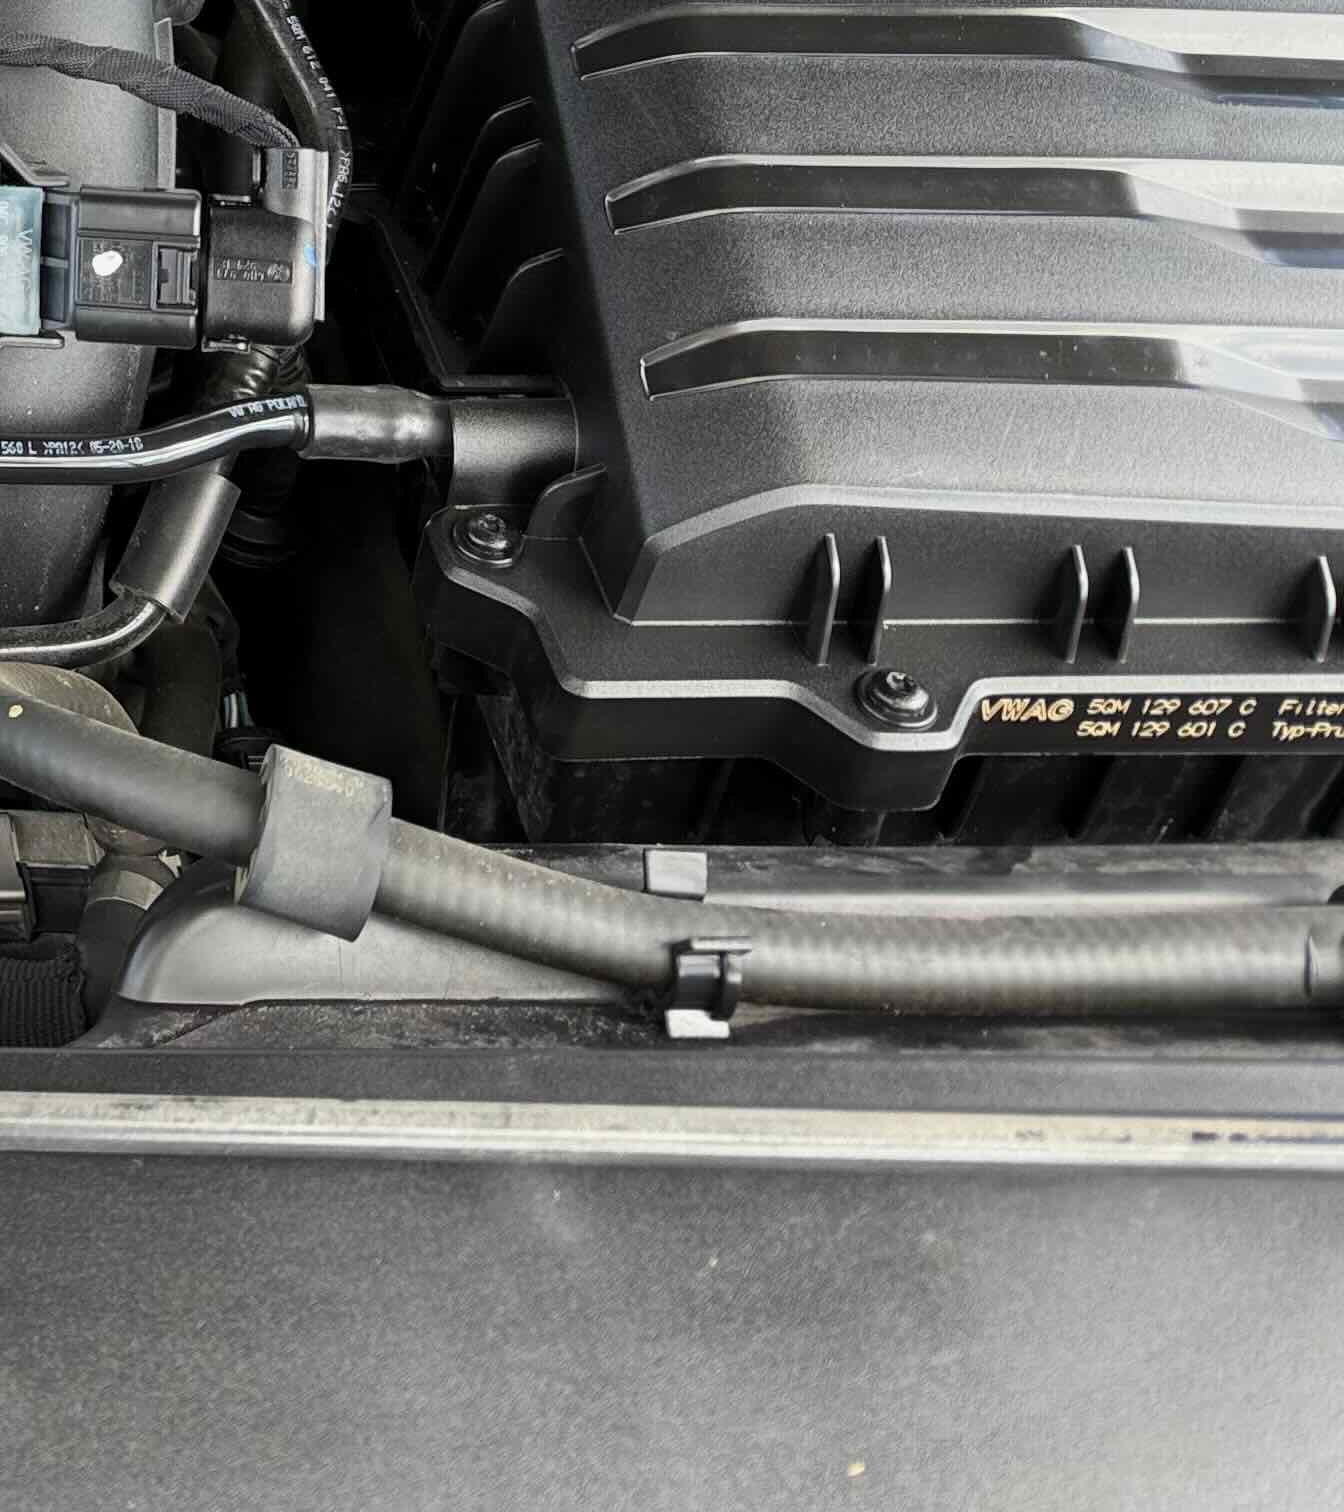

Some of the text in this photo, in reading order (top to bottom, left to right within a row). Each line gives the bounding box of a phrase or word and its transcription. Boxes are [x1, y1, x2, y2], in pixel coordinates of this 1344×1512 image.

[302, 45, 321, 70] 612
[28, 440, 37, 455] L
[1087, 698, 1129, 715] 5QM
[1141, 698, 1179, 715] 129
[1188, 698, 1229, 715] 607
[1240, 698, 1258, 715] C
[1076, 720, 1120, 738] 5QM
[1131, 720, 1169, 738] 129
[1178, 720, 1217, 738] 601
[1228, 721, 1247, 738] C
